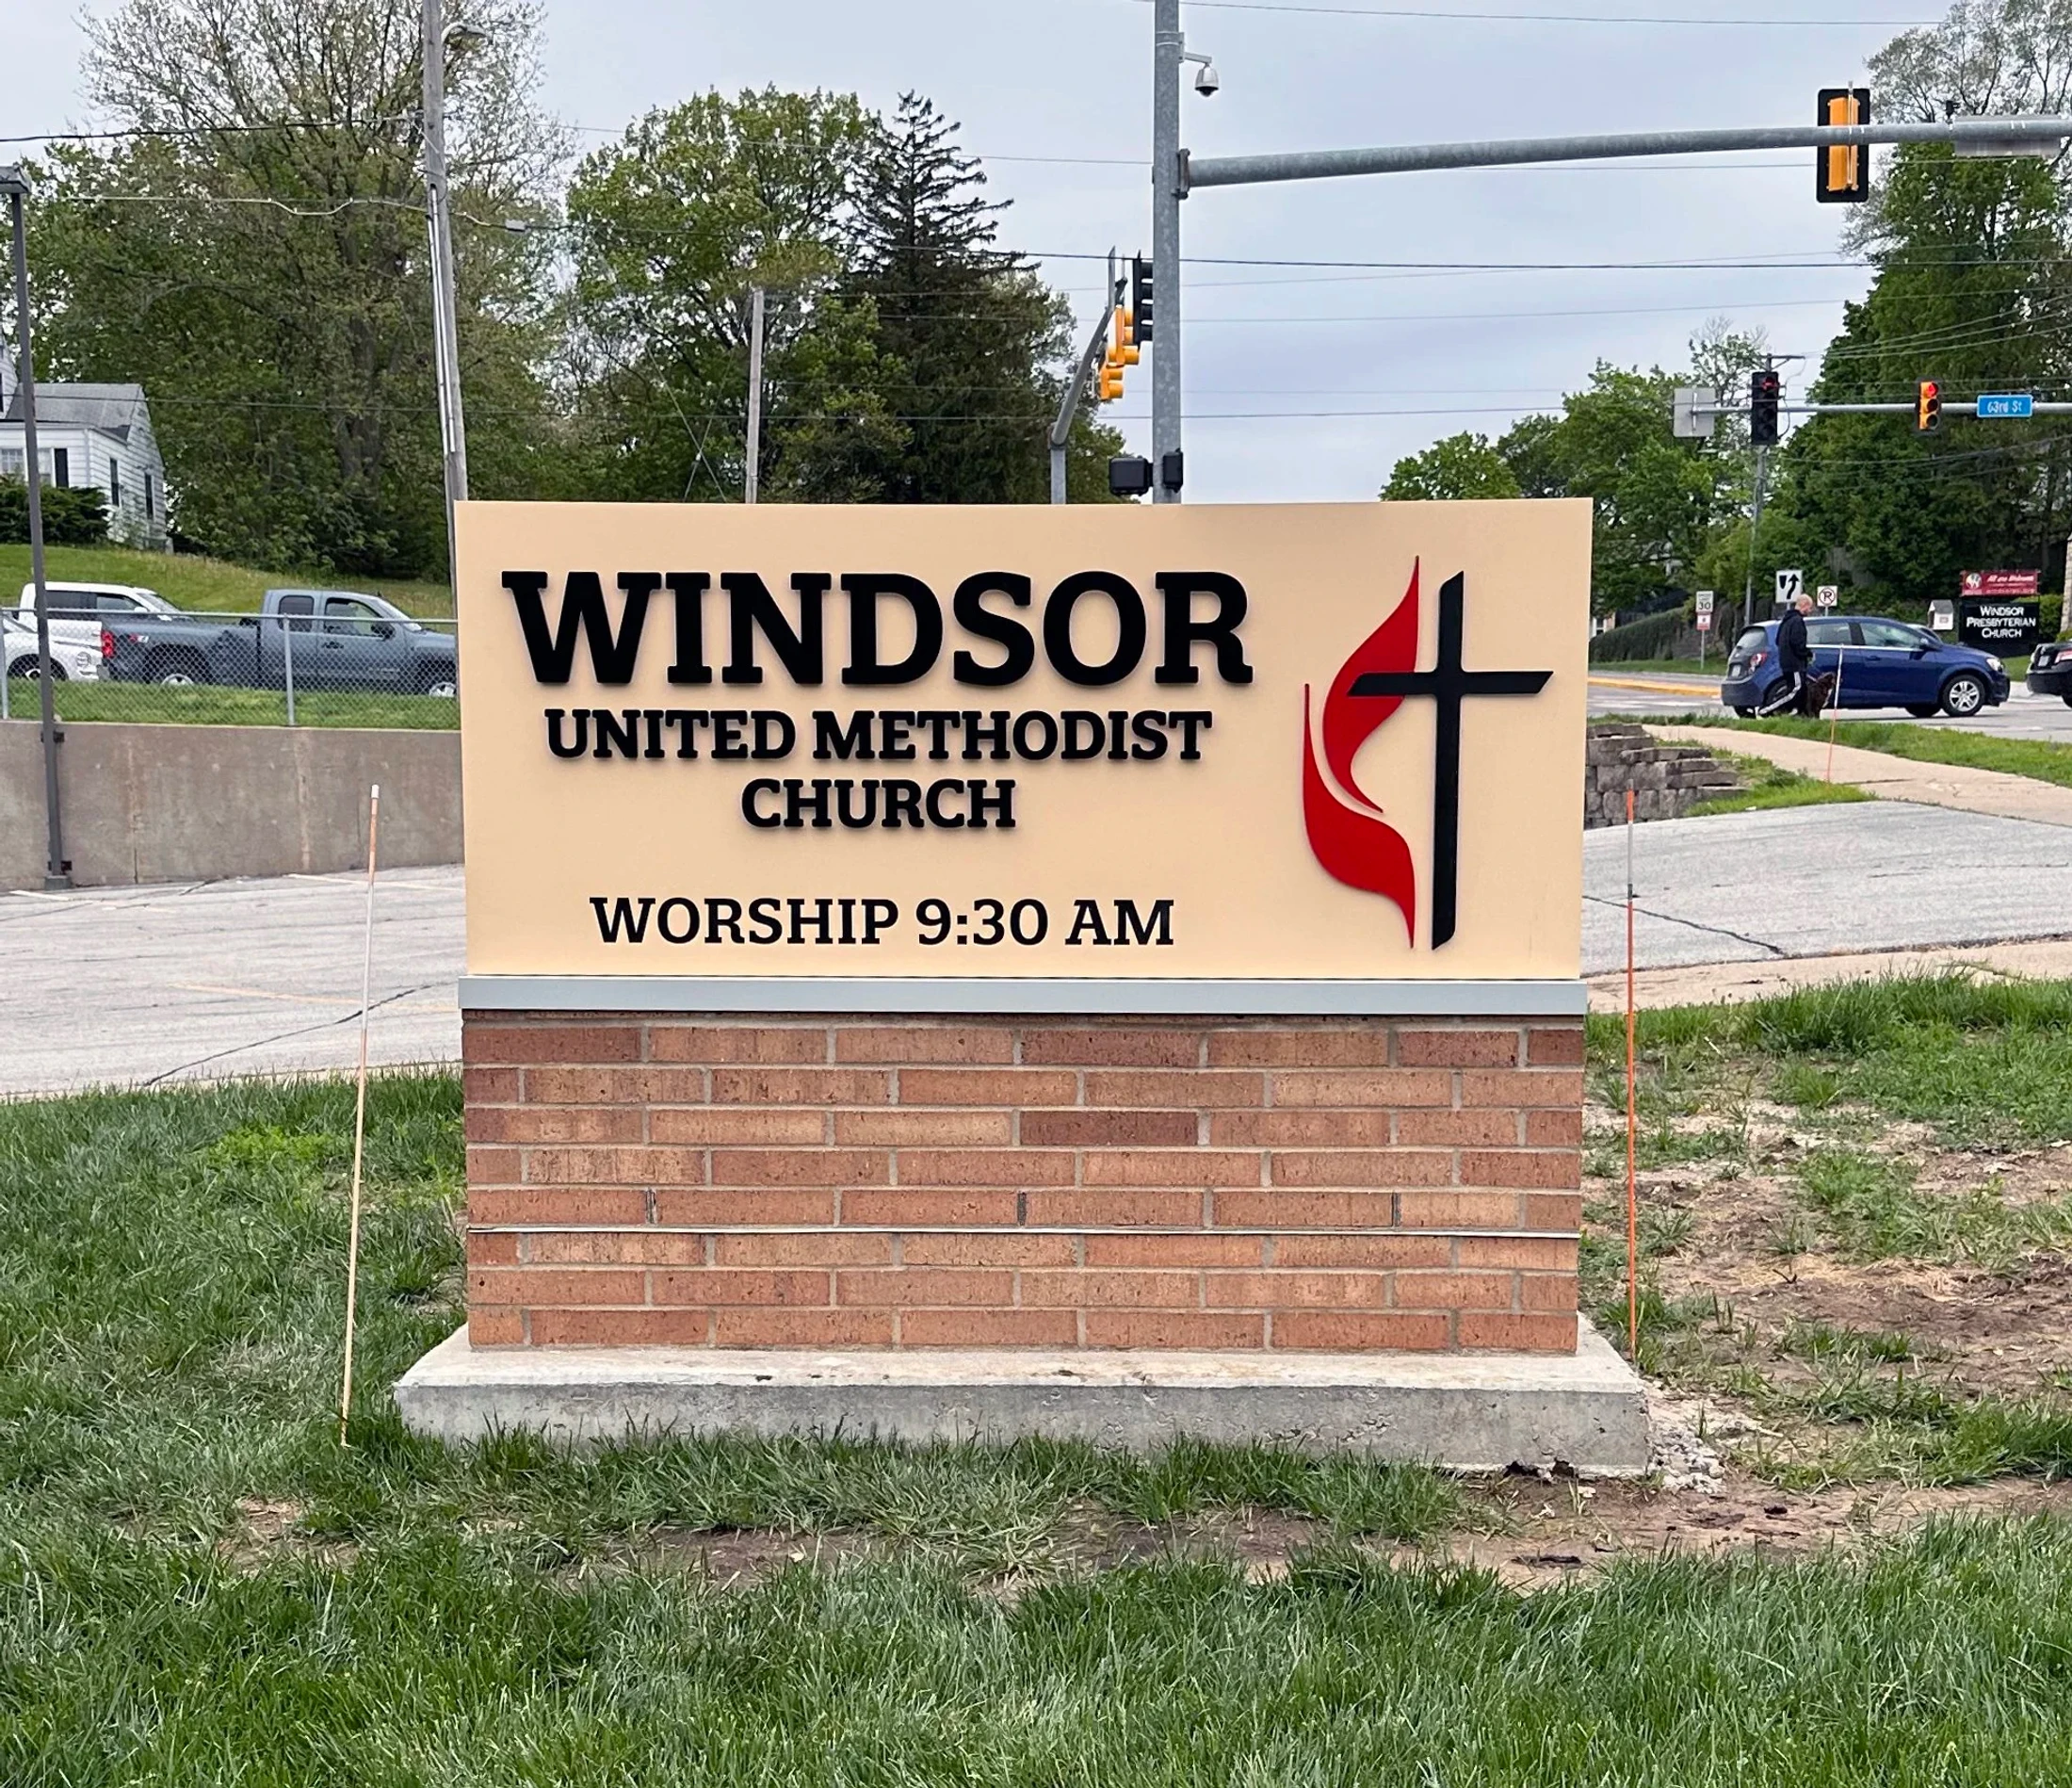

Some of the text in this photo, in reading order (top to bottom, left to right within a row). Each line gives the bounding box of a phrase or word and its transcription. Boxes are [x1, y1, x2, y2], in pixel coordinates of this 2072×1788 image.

[1987, 399, 2022, 414] 63rd St
[1698, 601, 1711, 610] 30
[1979, 606, 2024, 617] WINDSOR
[1966, 616, 2037, 627] PRESBYTERIAN
[501, 569, 1254, 690] WINDSOR
[1981, 626, 2022, 639] CHURCH
[544, 708, 1214, 763] UNITED METHODIST
[740, 778, 1016, 831] CHURCH
[589, 897, 1174, 946] WORSHIP 9:30 AM
